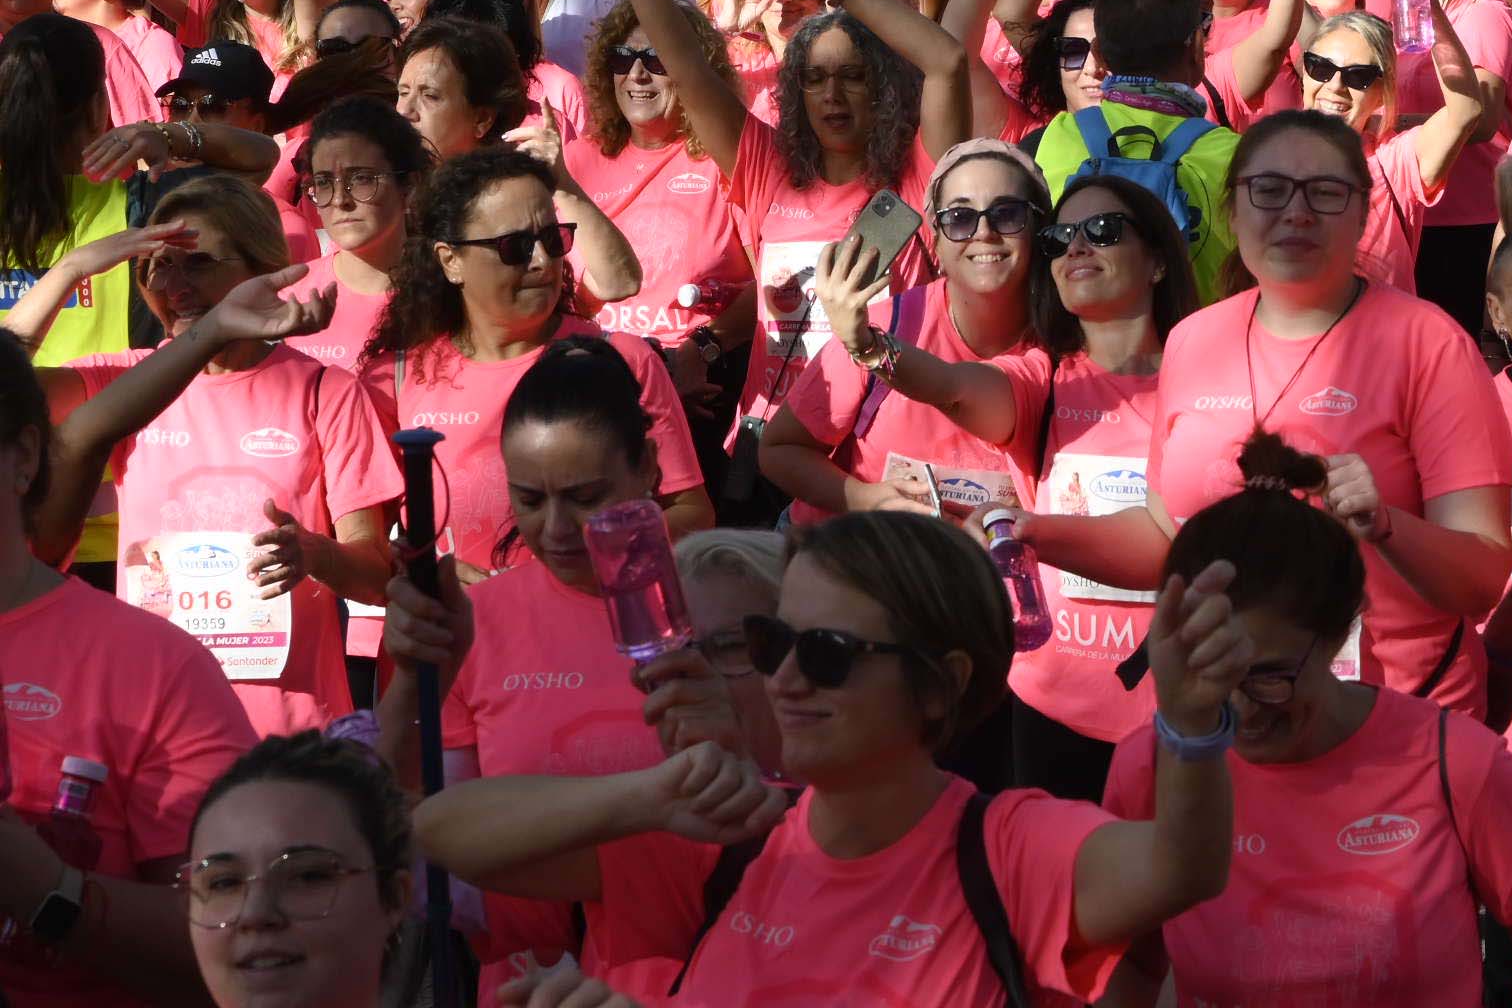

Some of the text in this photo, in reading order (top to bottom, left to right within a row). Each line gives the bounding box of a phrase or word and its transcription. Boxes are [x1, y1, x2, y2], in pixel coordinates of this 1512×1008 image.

[191, 57, 222, 67] adidas
[768, 202, 815, 220] OYSHO
[1194, 395, 1252, 410] OYSHO
[412, 411, 480, 427] OYSHO
[1056, 405, 1120, 424] OYSHO
[176, 558, 236, 571] ASTURIANA
[178, 590, 233, 610] 016
[185, 617, 226, 630] 19359
[202, 635, 274, 646] LA MUJER 2023
[226, 656, 279, 667] Santander
[503, 671, 585, 691] OYSHO
[1345, 827, 1414, 849] ASTURIANA
